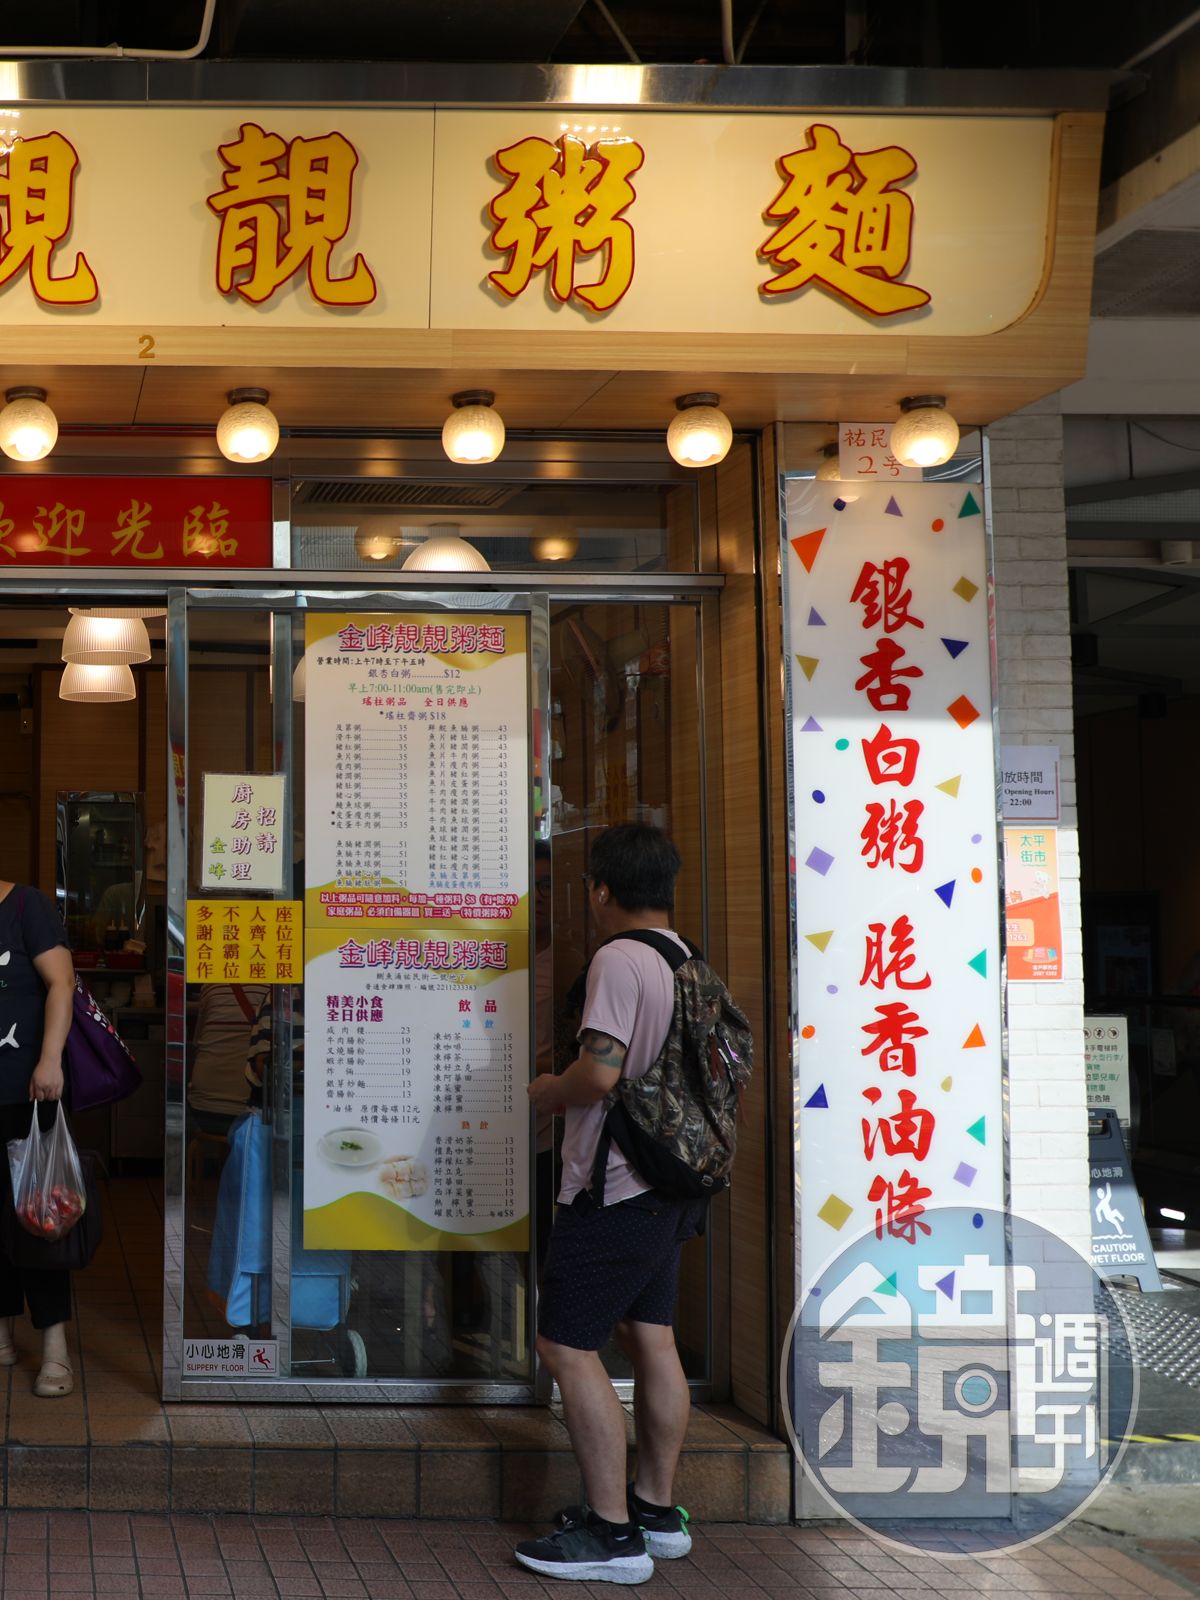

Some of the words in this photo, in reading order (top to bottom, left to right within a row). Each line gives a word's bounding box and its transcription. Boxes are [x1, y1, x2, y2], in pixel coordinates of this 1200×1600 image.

[137, 334, 157, 360] 2
[843, 428, 888, 448] 祐民
[338, 623, 505, 653] 金峰靚靚粥麵
[444, 668, 460, 678] $12
[424, 697, 469, 708] 全日供應
[430, 711, 446, 720] $18
[849, 556, 926, 875] 銀杏白粥
[1000, 771, 1043, 784] 放時間
[1004, 788, 1032, 796] Opening
[1034, 788, 1055, 796] Hours
[1009, 798, 1032, 806] 22:00
[231, 782, 254, 881] 廚房助理
[256, 806, 277, 854] 招請
[208, 837, 228, 881] 金峰
[196, 906, 213, 979] 多謝合作
[223, 906, 240, 979] 不設霸位
[250, 906, 267, 979] 人齊入座
[276, 906, 293, 979] 座位有限
[338, 938, 508, 968] 金峰靚靚粥麵
[326, 996, 384, 1008] 精美小食
[459, 1000, 496, 1013] 飲品
[326, 1009, 384, 1022] 全日供應
[505, 1147, 514, 1155] 13
[1090, 1167, 1123, 1178] 心地滑
[1093, 1243, 1136, 1253] CAUTION
[1111, 1253, 1145, 1263] FLOOR
[186, 1344, 245, 1359] 小心地滑
